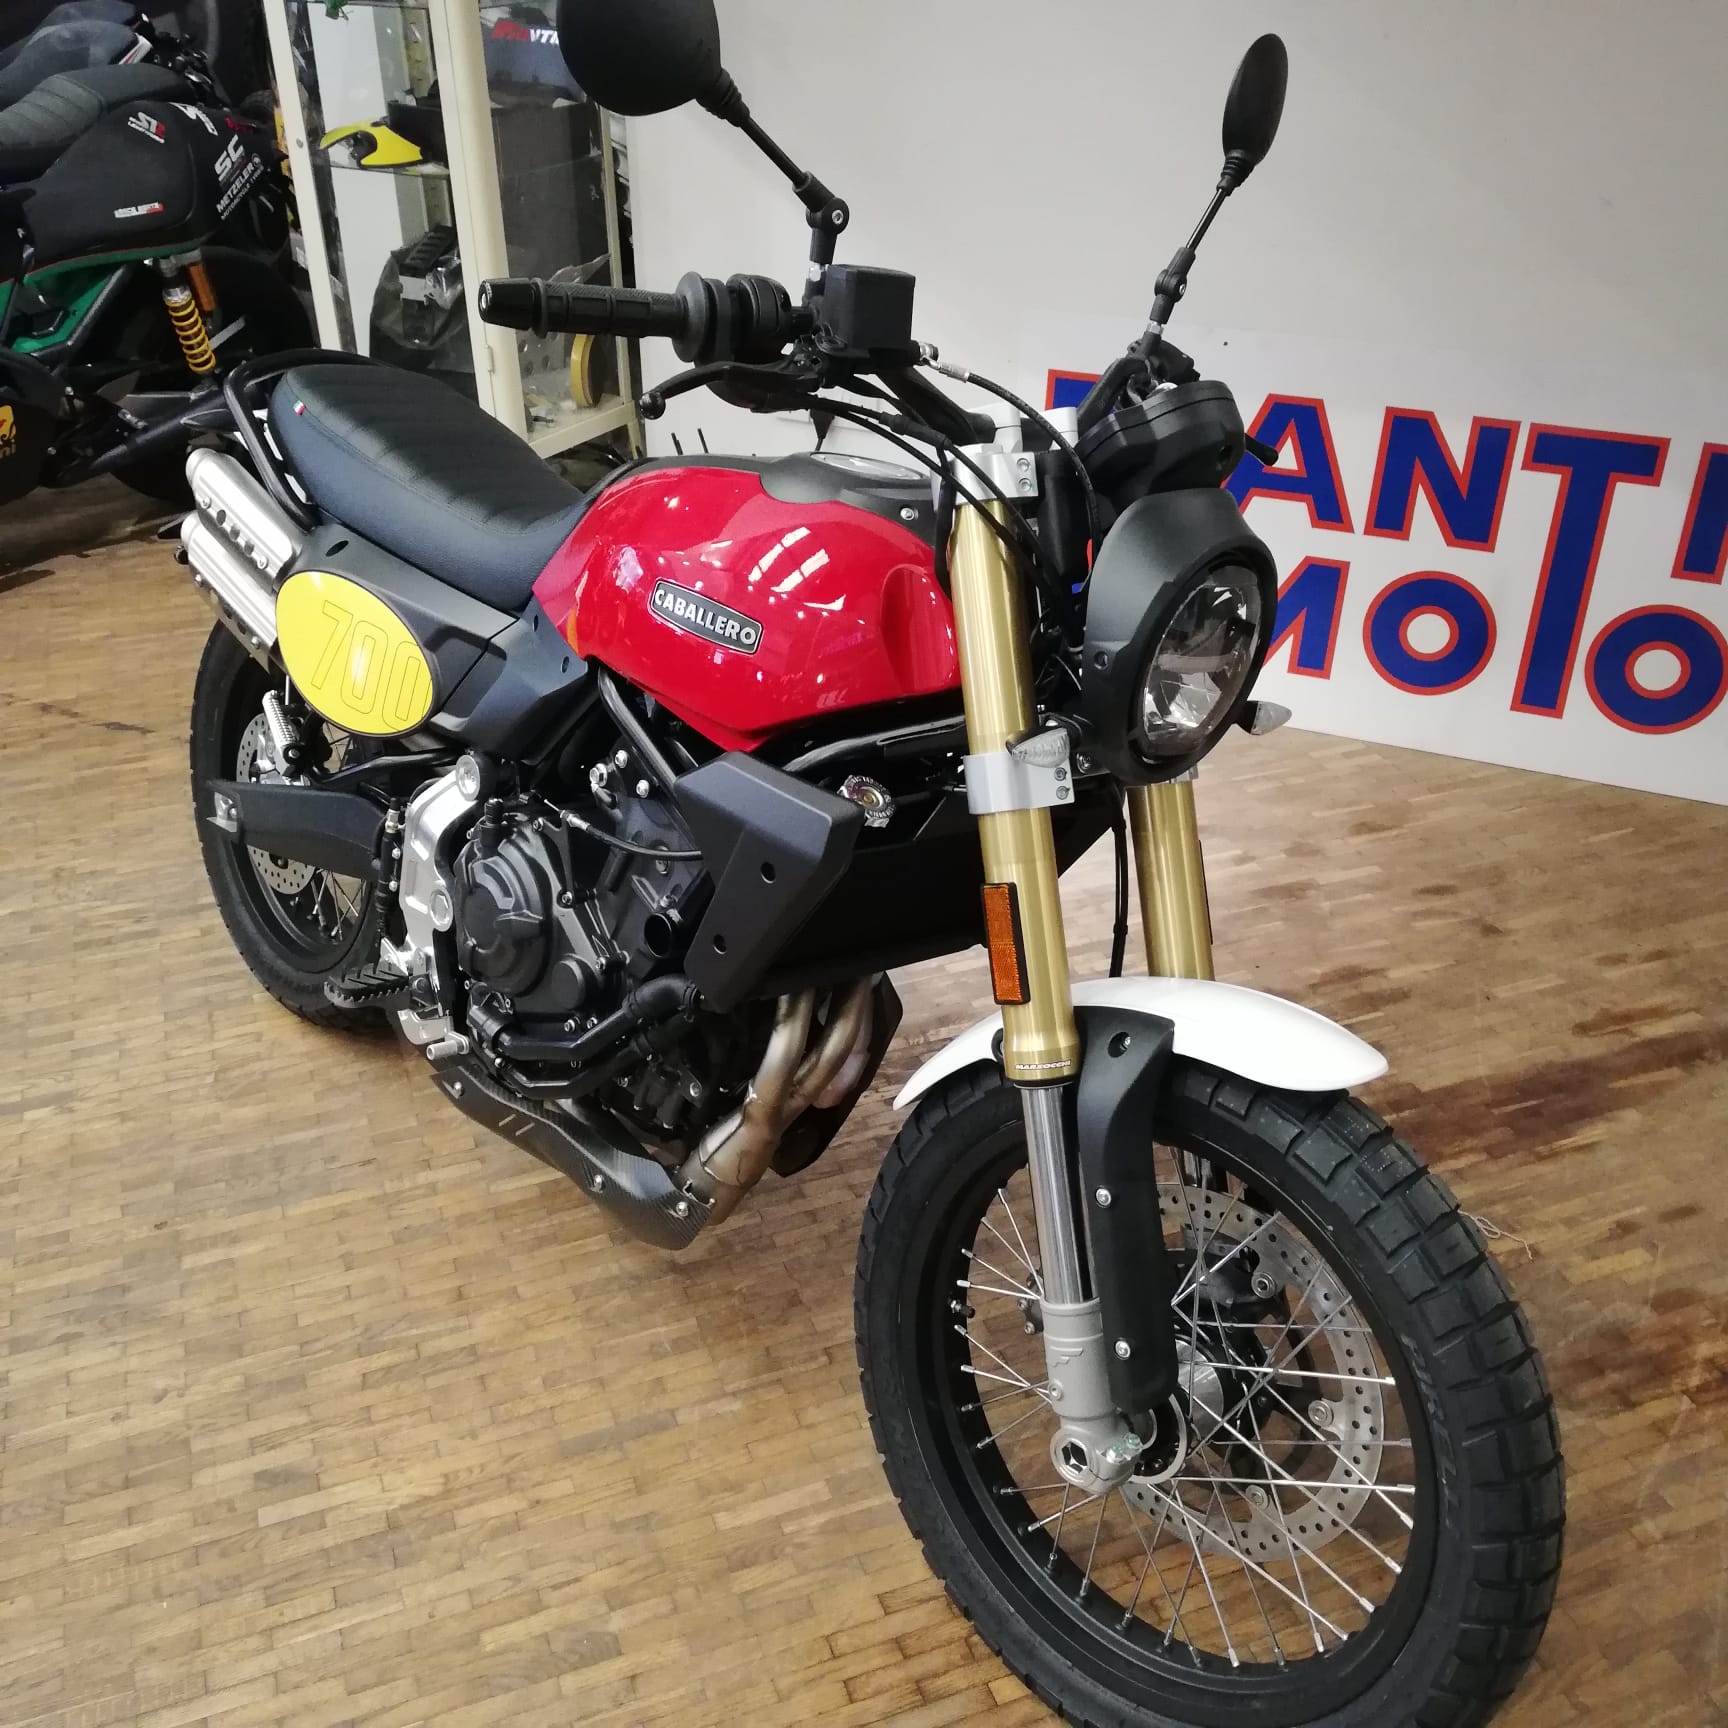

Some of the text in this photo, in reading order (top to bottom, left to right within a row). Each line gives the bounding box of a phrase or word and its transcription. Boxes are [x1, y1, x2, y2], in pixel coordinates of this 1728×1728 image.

[216, 162, 255, 213] METZELER
[654, 589, 757, 645] CABALLERO
[310, 600, 433, 731] 700
[1015, 1059, 1072, 1071] MARZOCCHI
